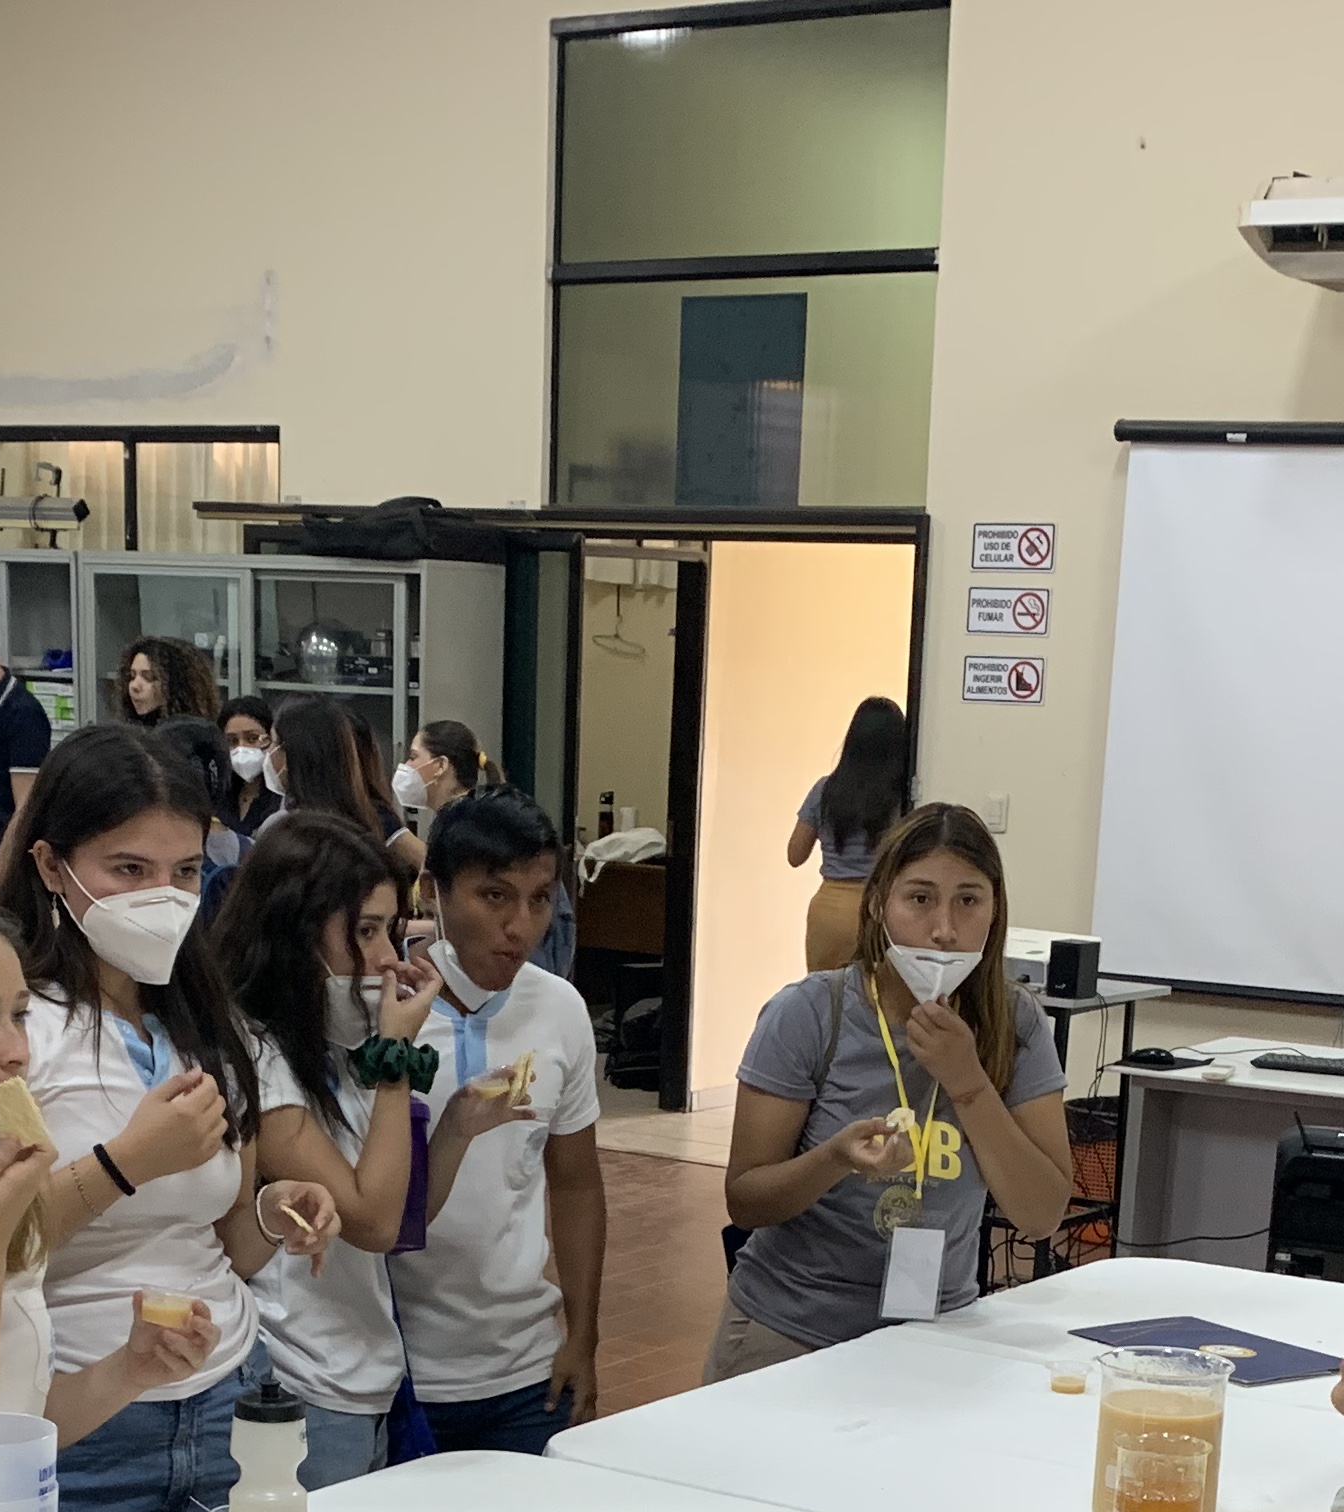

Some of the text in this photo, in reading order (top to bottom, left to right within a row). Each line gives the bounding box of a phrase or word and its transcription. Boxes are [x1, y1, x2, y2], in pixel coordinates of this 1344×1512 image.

[977, 530, 1019, 540] PROHIBIDO
[983, 542, 1012, 551] USO DE
[979, 553, 1014, 563] CELULAR
[971, 599, 1012, 609] PROHIBIDO
[977, 612, 1004, 622] FUMAR
[968, 663, 1009, 673] PROHIBIDO
[972, 674, 1003, 684] INGERIR
[966, 686, 1008, 696] ALIMENTOS
